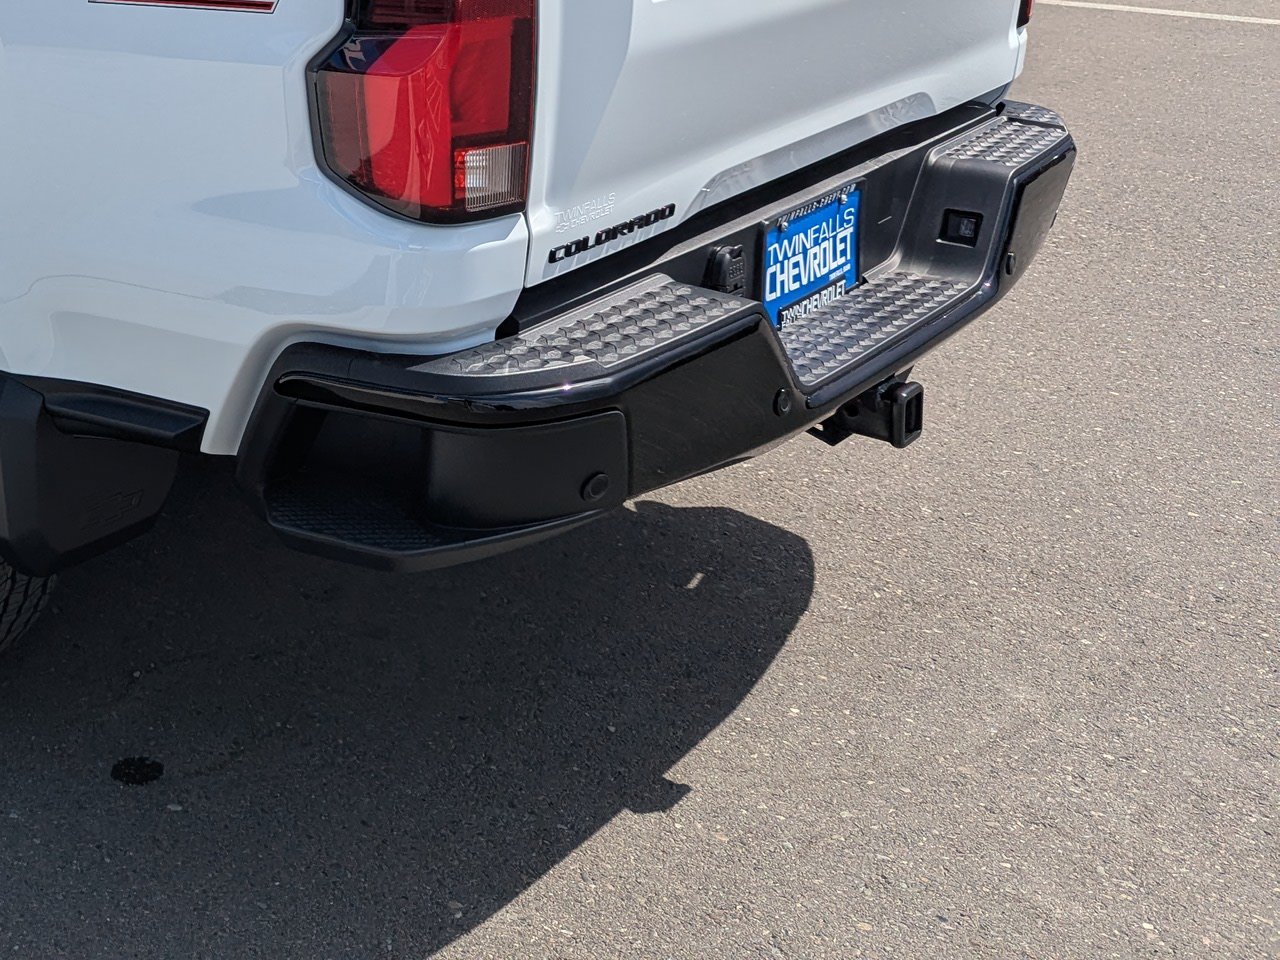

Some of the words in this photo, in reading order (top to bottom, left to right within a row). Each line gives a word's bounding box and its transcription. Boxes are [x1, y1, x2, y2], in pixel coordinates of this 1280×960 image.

[548, 203, 676, 264] COLORADO
[768, 207, 855, 266] TWINFALLS
[765, 227, 854, 302] CHEVROLET
[801, 280, 847, 318] CHEVROLET
